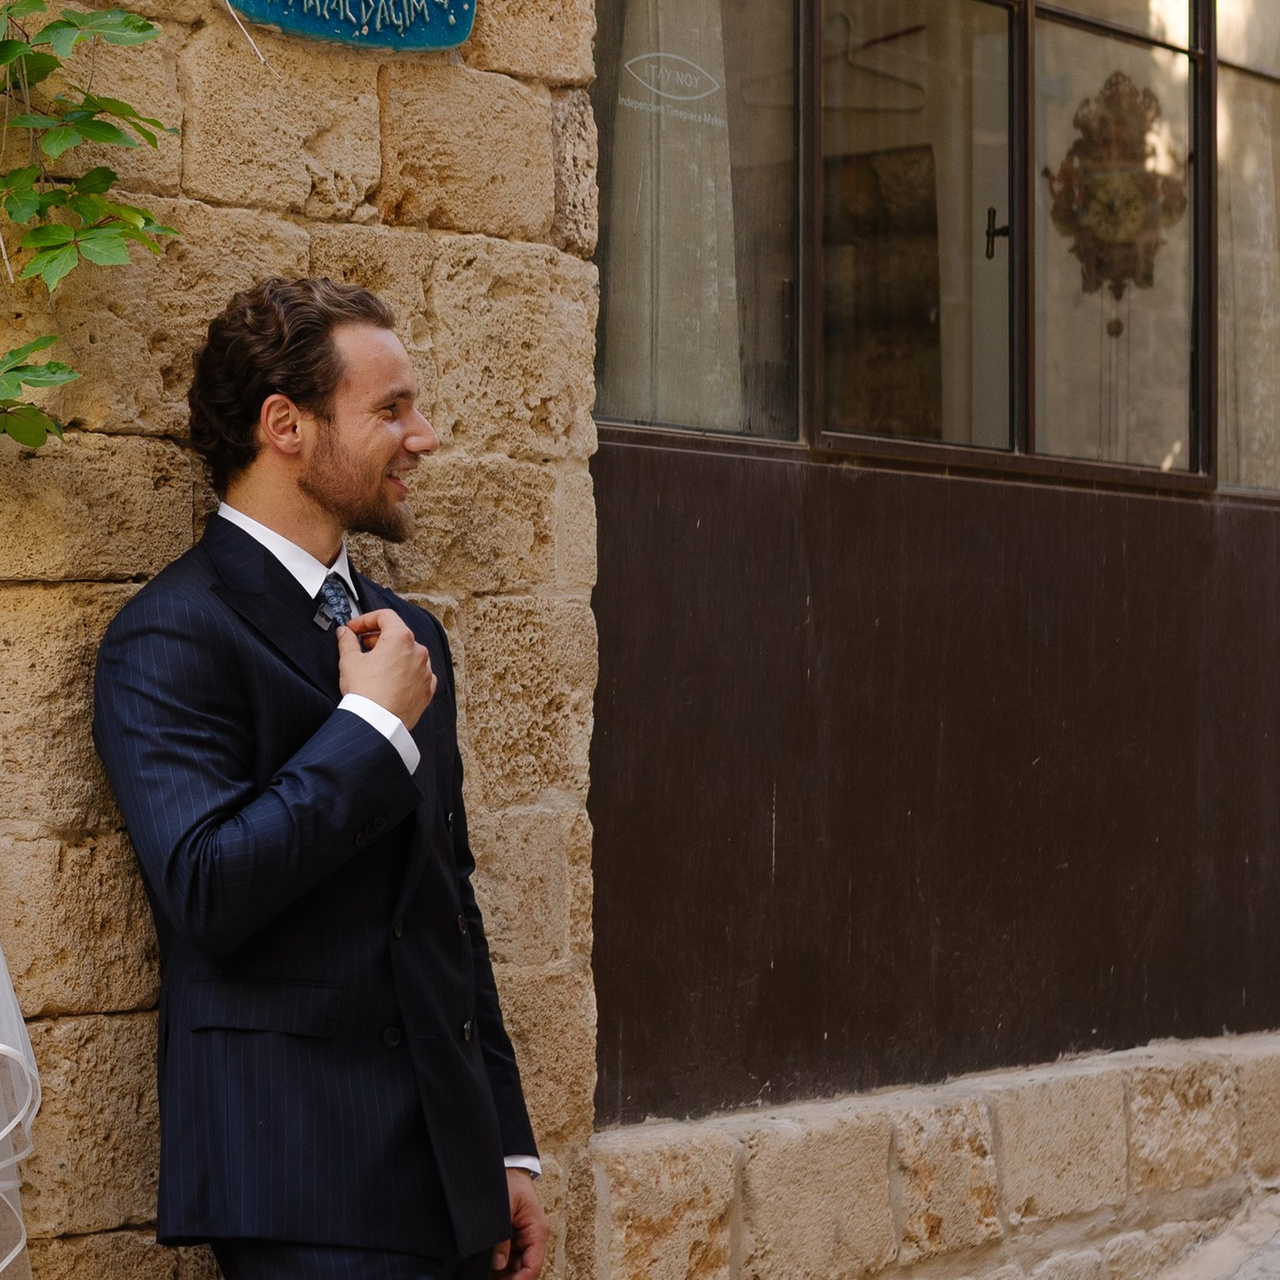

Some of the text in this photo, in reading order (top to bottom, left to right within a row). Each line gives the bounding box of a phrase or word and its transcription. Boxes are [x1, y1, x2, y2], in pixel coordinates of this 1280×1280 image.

[645, 64, 700, 89] ITAY NOY
[618, 93, 727, 128] Independent Timepiece Maker
